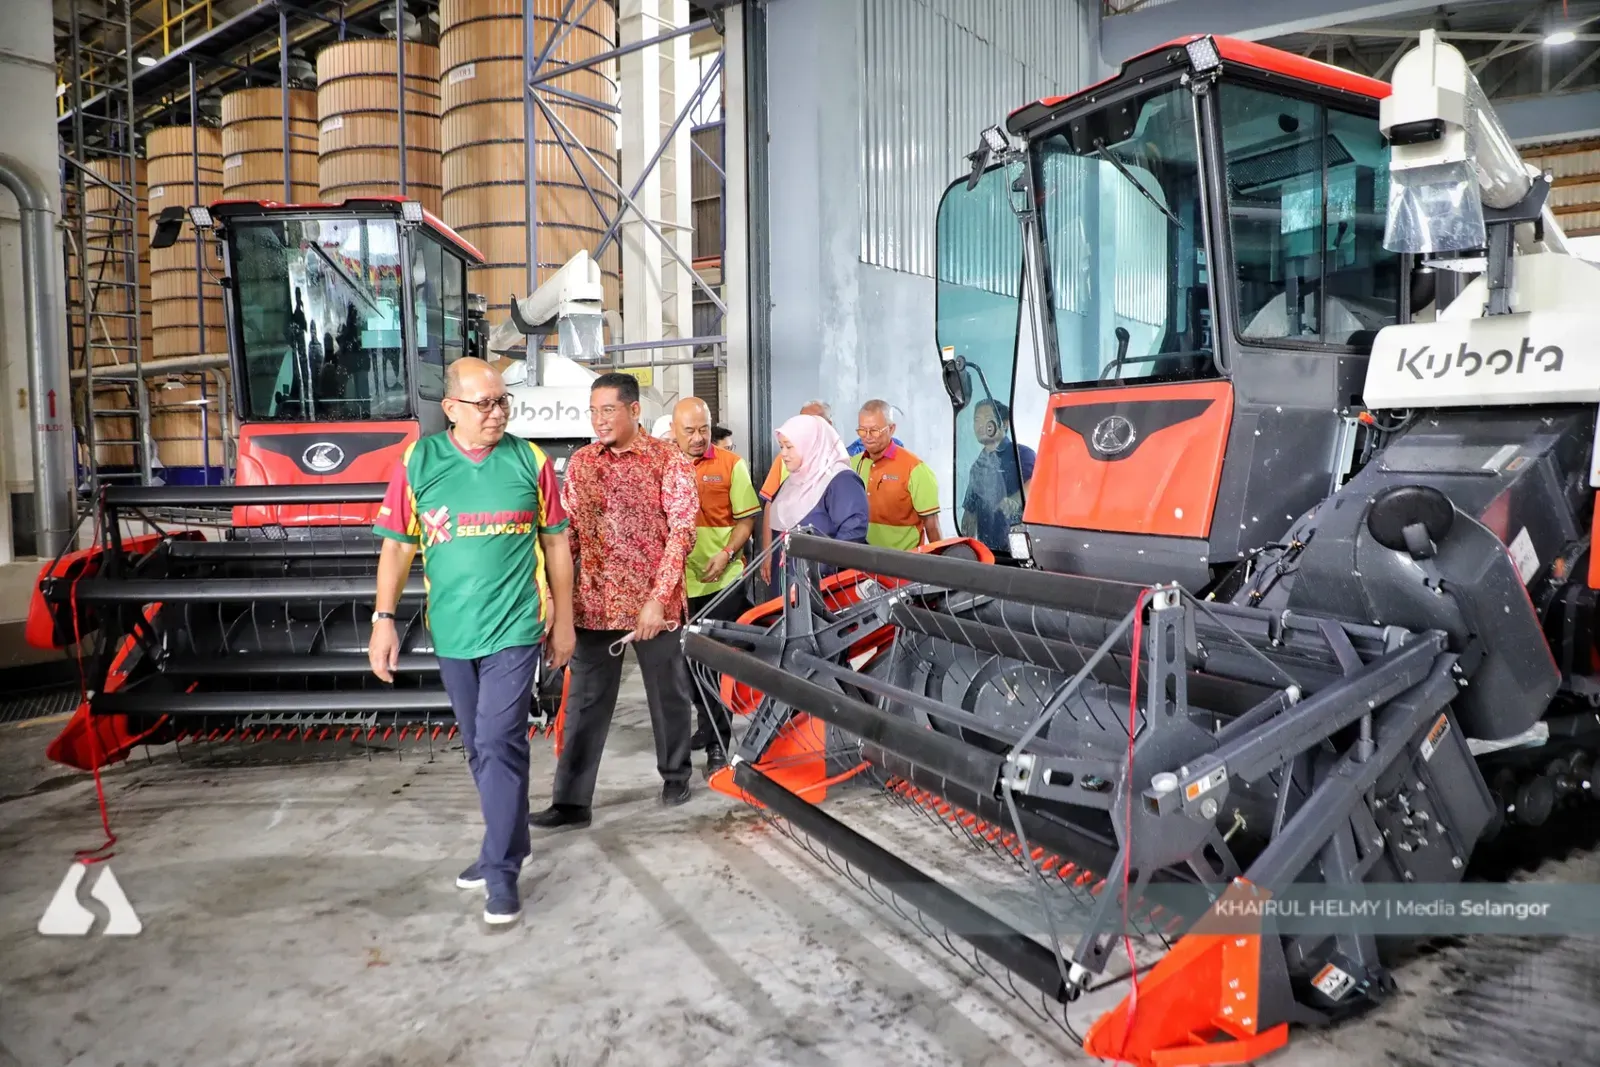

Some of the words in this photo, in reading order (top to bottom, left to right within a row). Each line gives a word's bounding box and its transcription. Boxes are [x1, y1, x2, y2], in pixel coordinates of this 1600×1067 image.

[1397, 337, 1564, 380] Kubota
[508, 400, 580, 421] ubota
[457, 511, 535, 526] RUMPUN
[456, 523, 532, 538] SELANGOR
